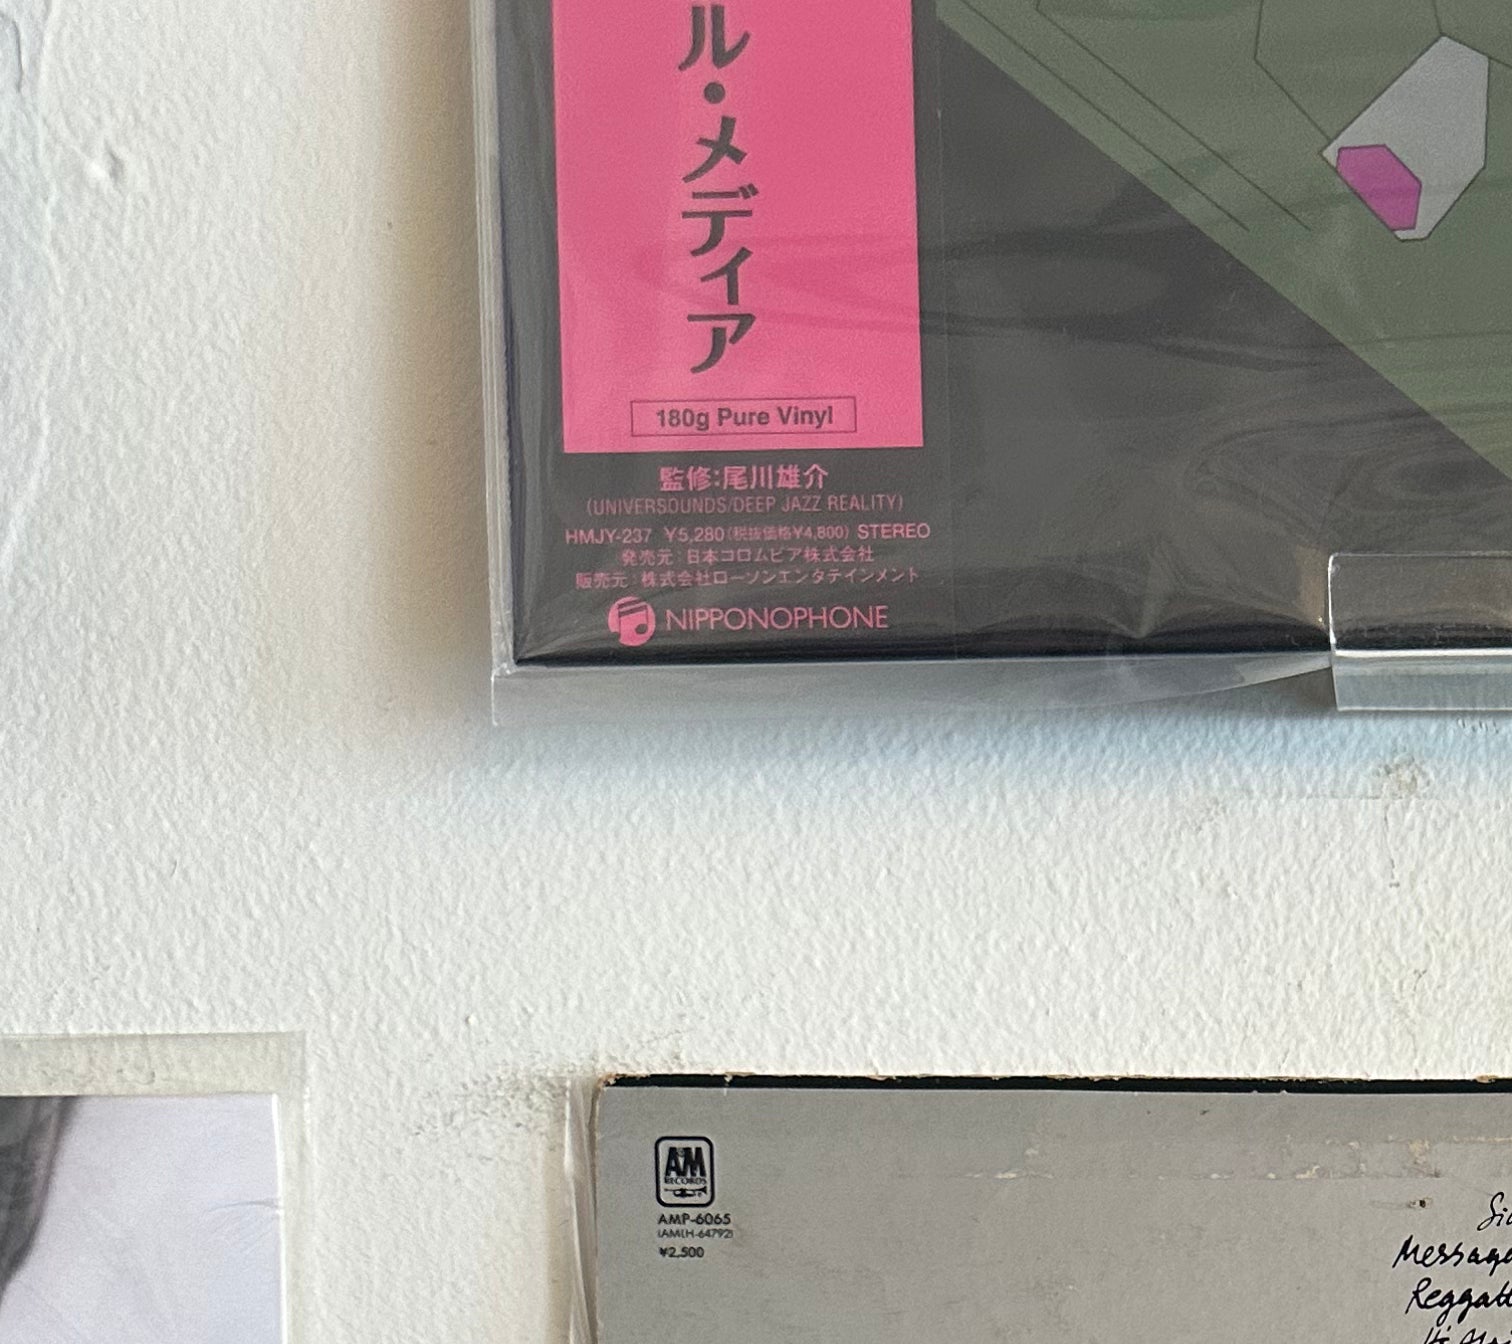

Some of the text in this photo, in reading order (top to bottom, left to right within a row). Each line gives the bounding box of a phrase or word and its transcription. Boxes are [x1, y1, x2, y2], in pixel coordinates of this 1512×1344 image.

[656, 405, 833, 431] 180g Pure Vinyl
[587, 494, 904, 516] (UNIVERSOUNDS/DEEP JAZZ REALITY)
[565, 528, 652, 545] HMJY-237
[857, 522, 931, 540] STEREO
[665, 605, 889, 631] NIPPONOPHONE
[657, 1213, 731, 1225] AMP-6065
[658, 1246, 705, 1258] ¥2,500
